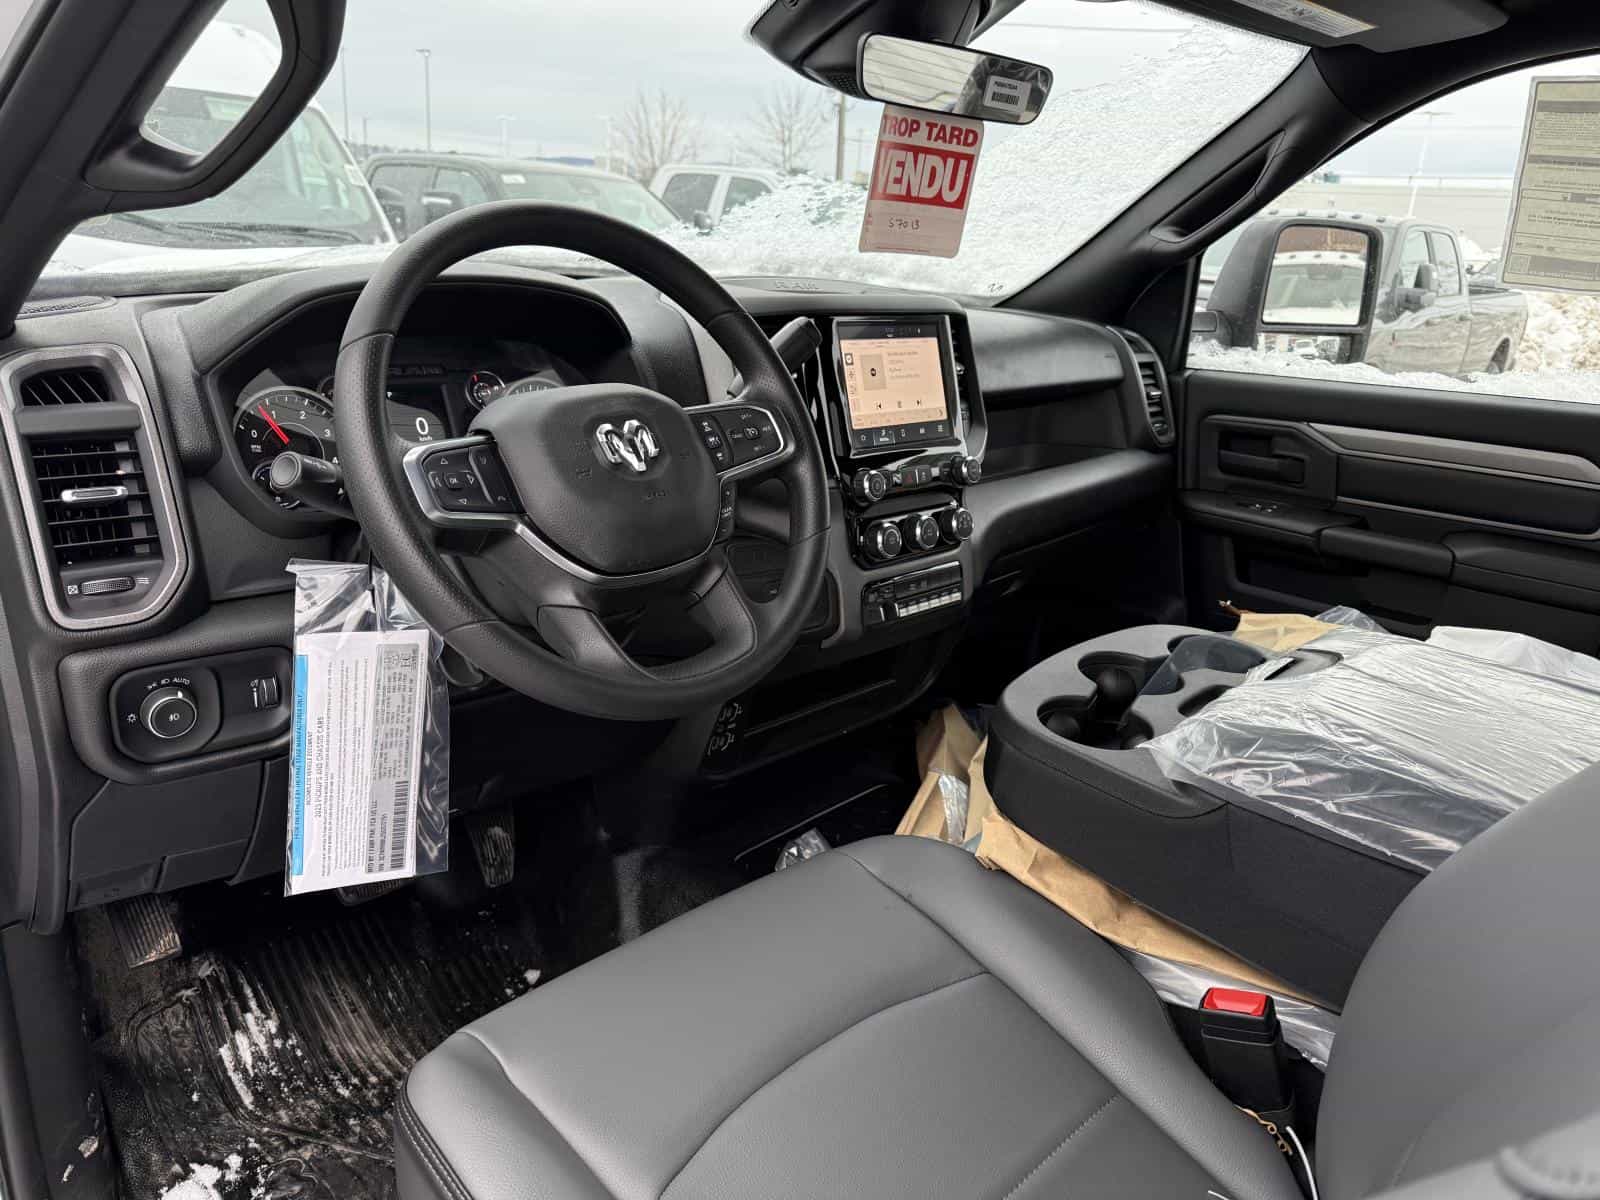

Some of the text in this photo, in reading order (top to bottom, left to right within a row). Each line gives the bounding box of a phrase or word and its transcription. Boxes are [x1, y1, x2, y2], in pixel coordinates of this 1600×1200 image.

[925, 121, 978, 147] TARD
[878, 147, 968, 203] VENDU
[300, 411, 307, 419] 2
[415, 417, 429, 435] 0
[251, 429, 258, 438] 0
[324, 428, 331, 437] 3
[172, 676, 190, 685] AUTO
